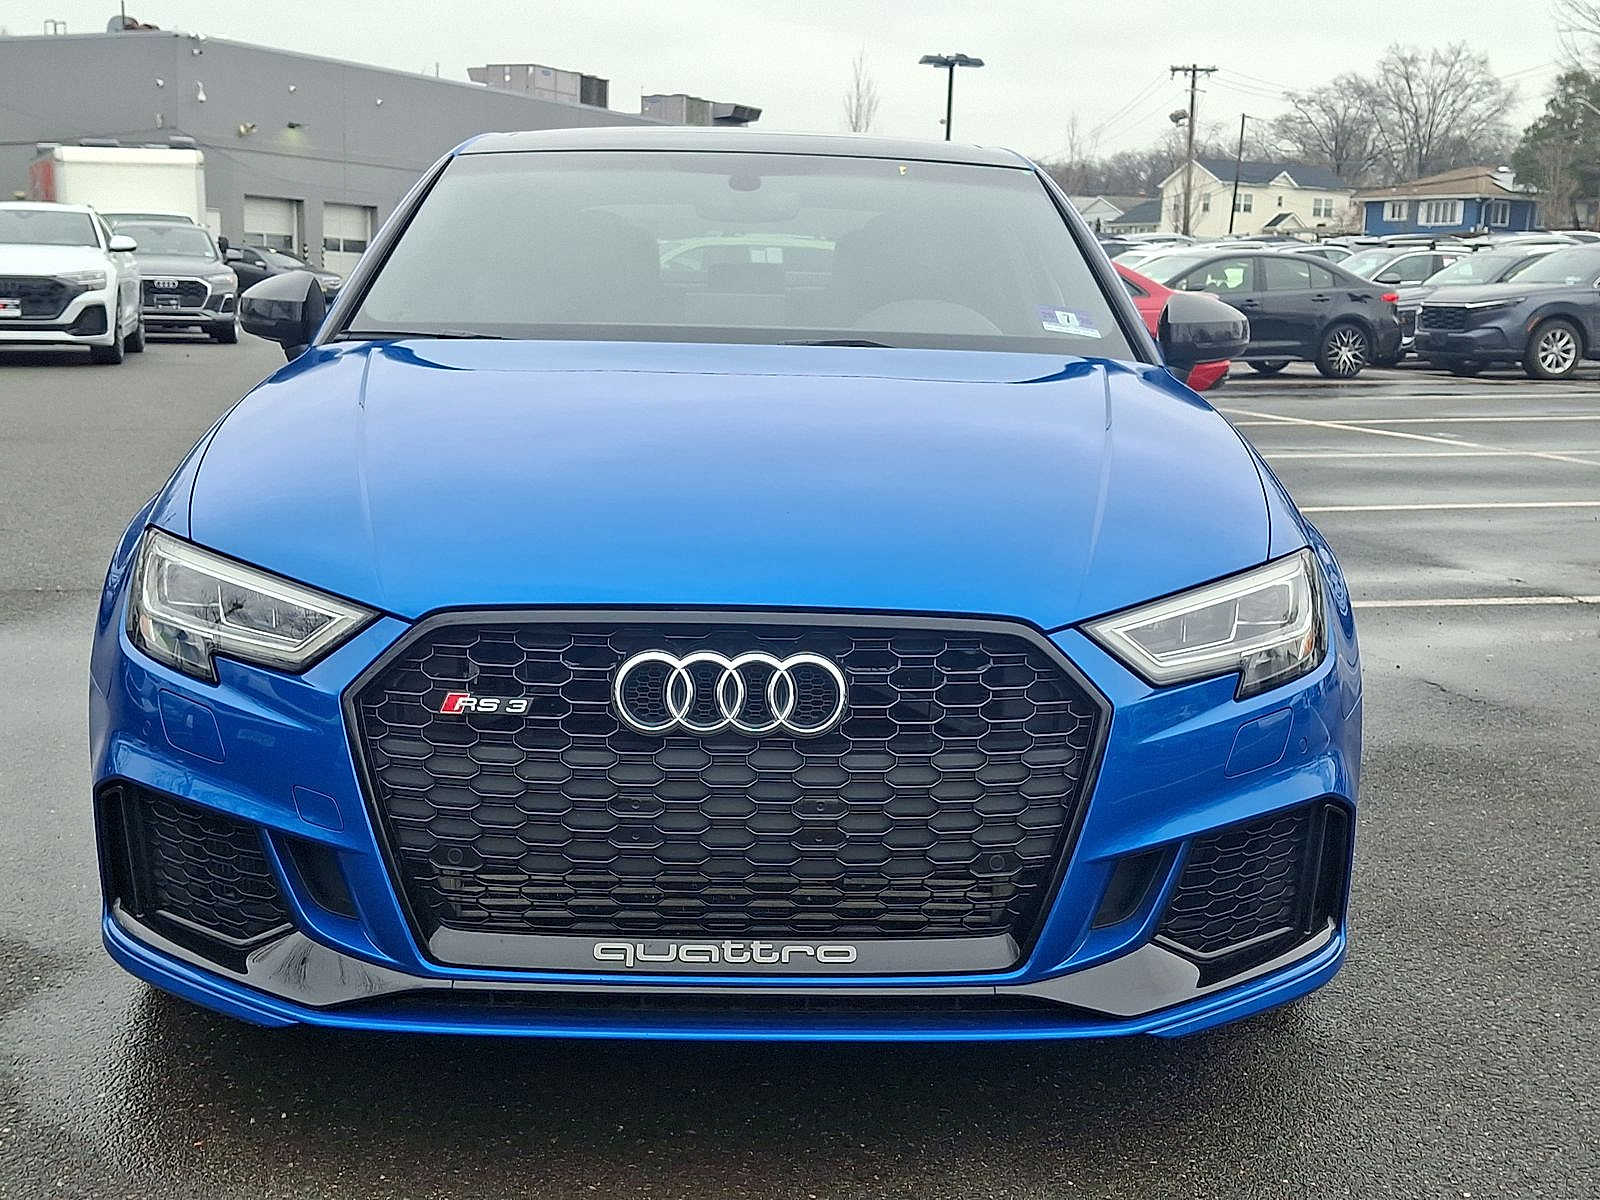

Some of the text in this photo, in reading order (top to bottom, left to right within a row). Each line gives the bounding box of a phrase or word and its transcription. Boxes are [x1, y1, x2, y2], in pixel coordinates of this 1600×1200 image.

[453, 697, 528, 713] RS 3
[593, 940, 858, 968] quattro
